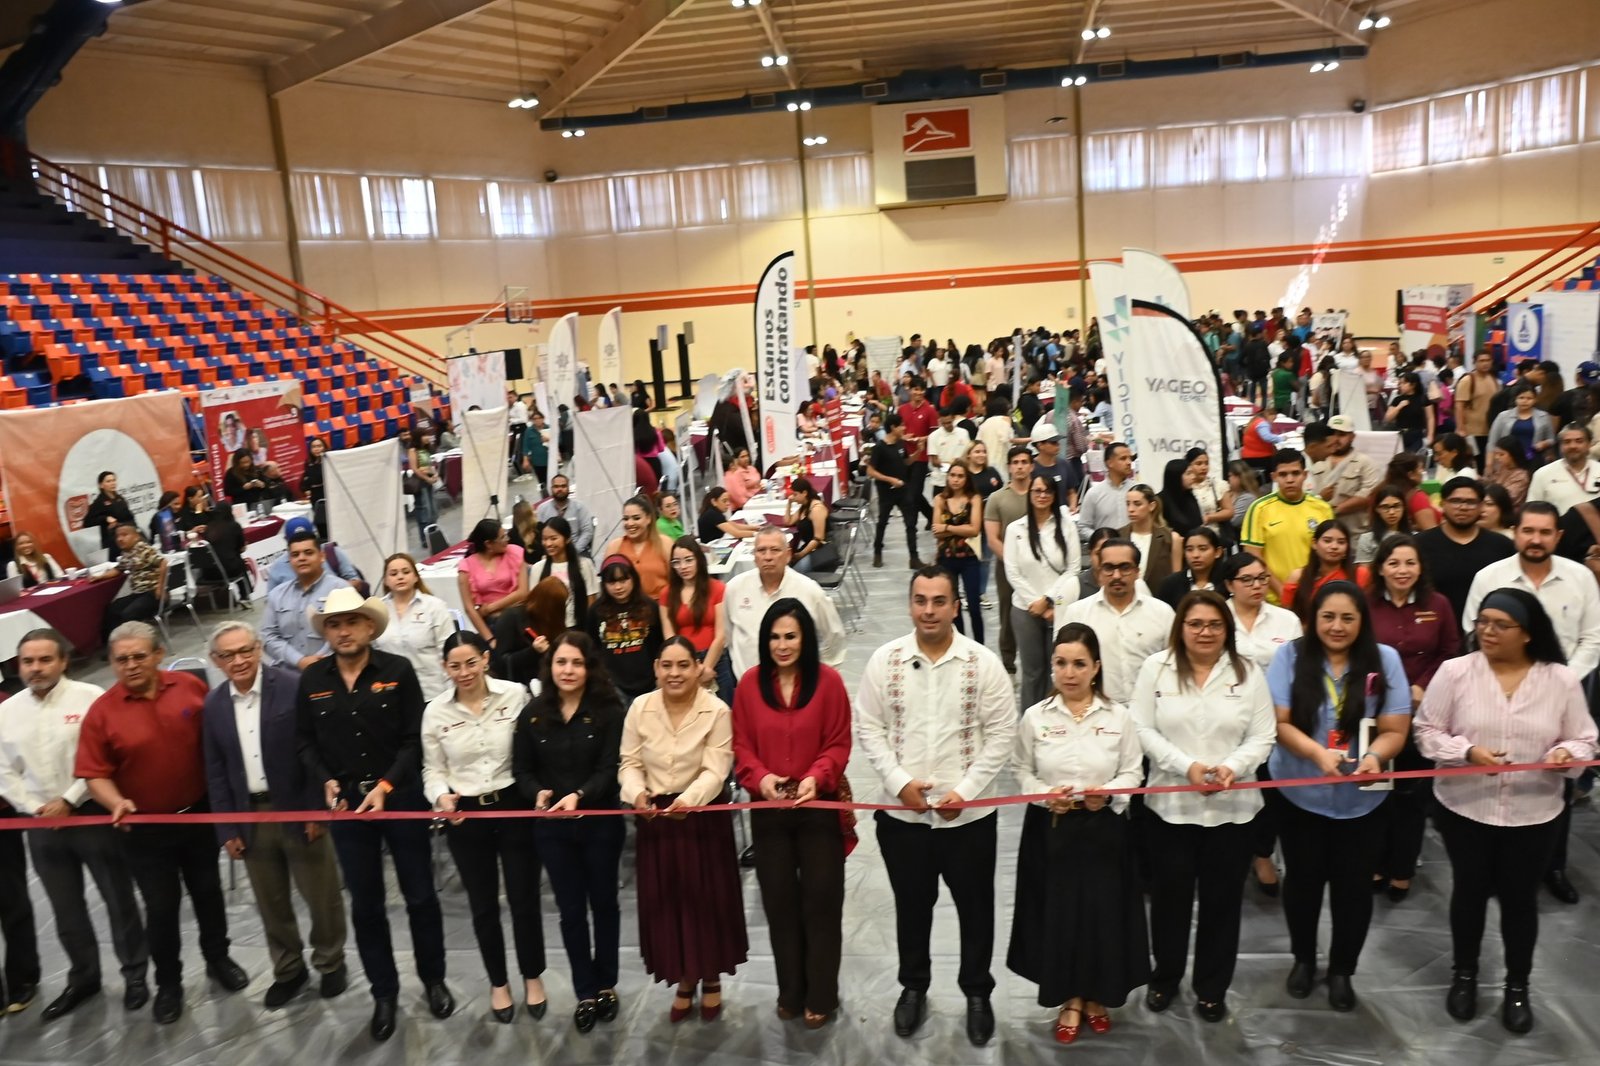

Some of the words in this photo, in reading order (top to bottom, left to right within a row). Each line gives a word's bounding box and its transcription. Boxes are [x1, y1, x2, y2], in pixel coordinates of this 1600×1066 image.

[764, 309, 775, 401] Estamos
[775, 267, 789, 403] contratando
[1145, 376, 1207, 395] YAGEO
[212, 443, 223, 486] Victoria
